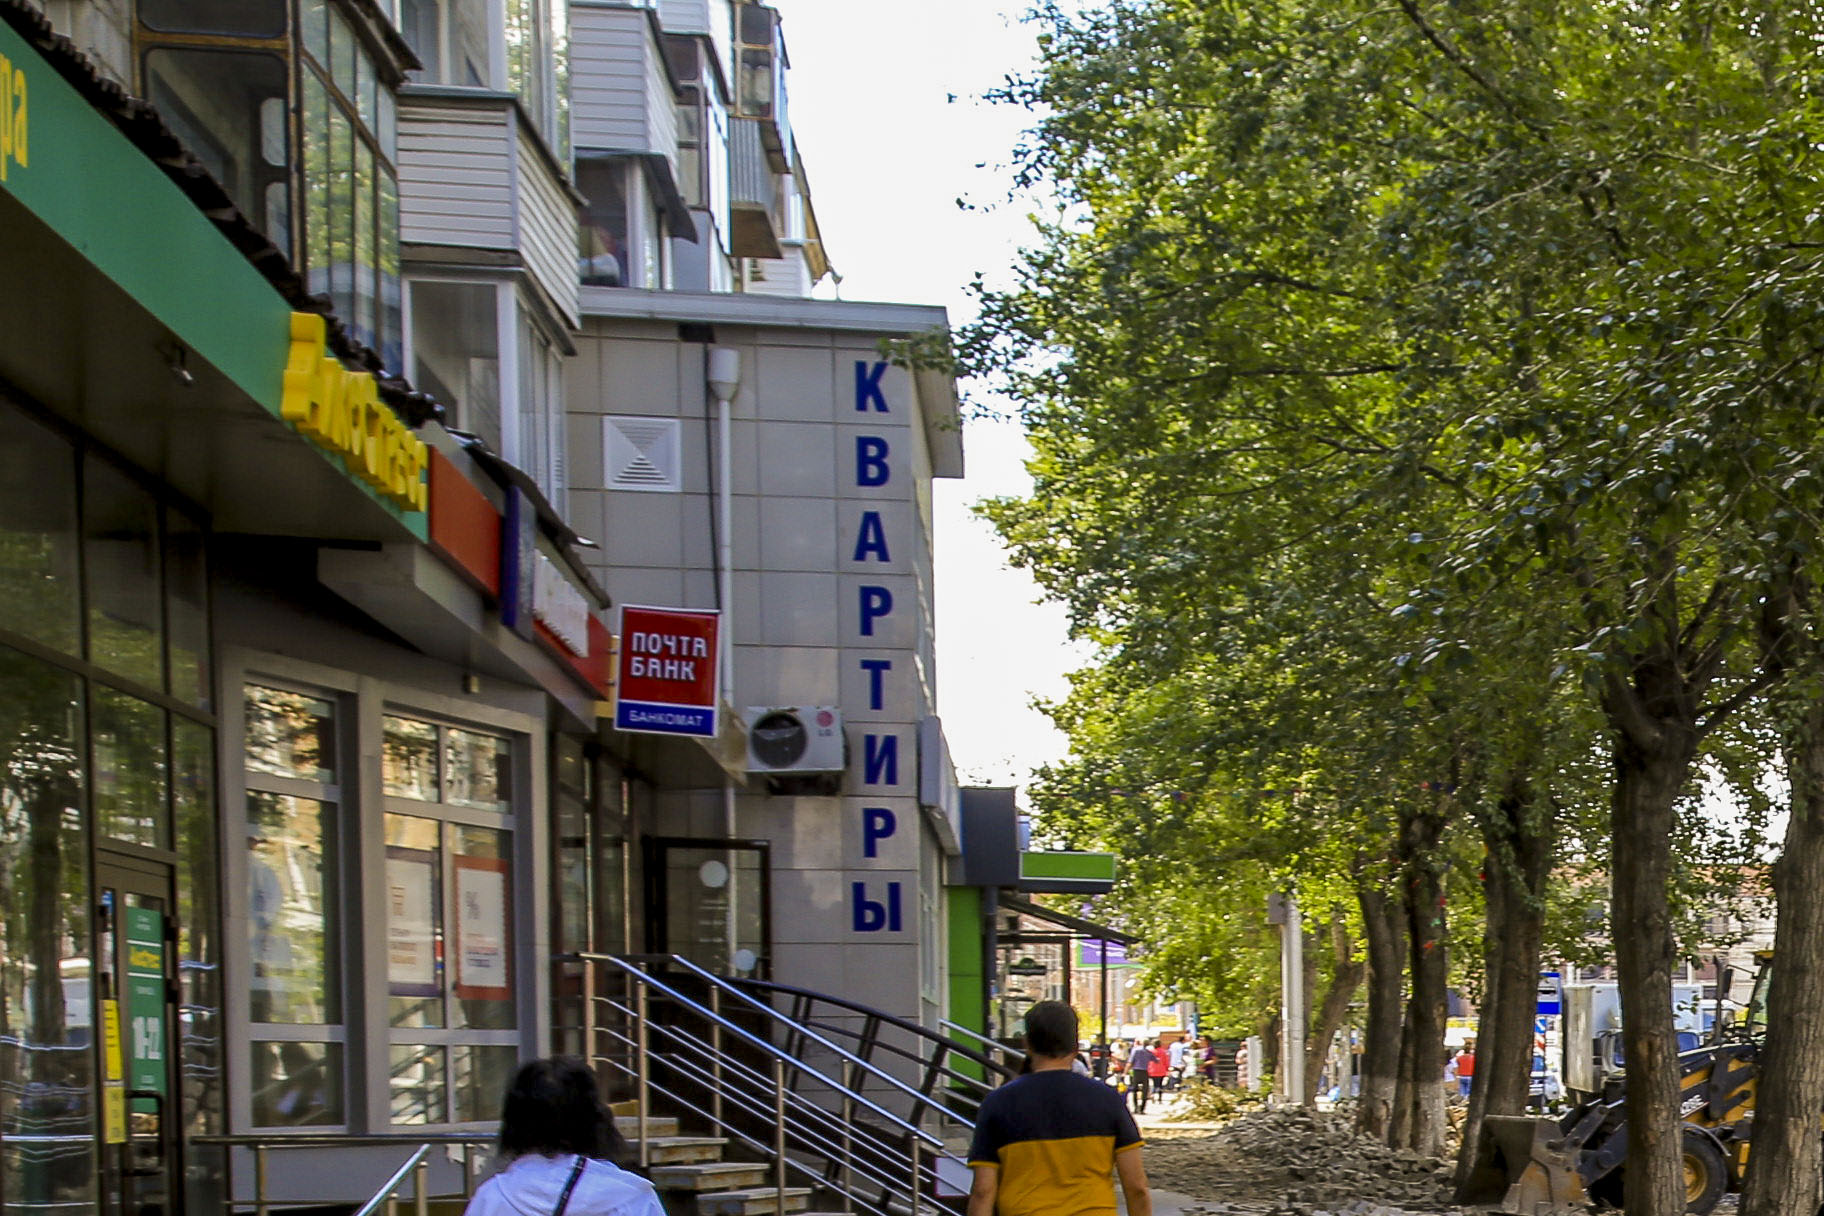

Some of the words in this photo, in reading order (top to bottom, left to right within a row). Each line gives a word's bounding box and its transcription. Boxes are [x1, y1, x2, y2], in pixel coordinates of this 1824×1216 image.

[631, 631, 708, 658] ПОЧТА
[851, 360, 903, 932] КВАРТИРЫ
[630, 656, 696, 681] БАНК
[629, 710, 704, 726] БАНКОМАТ
